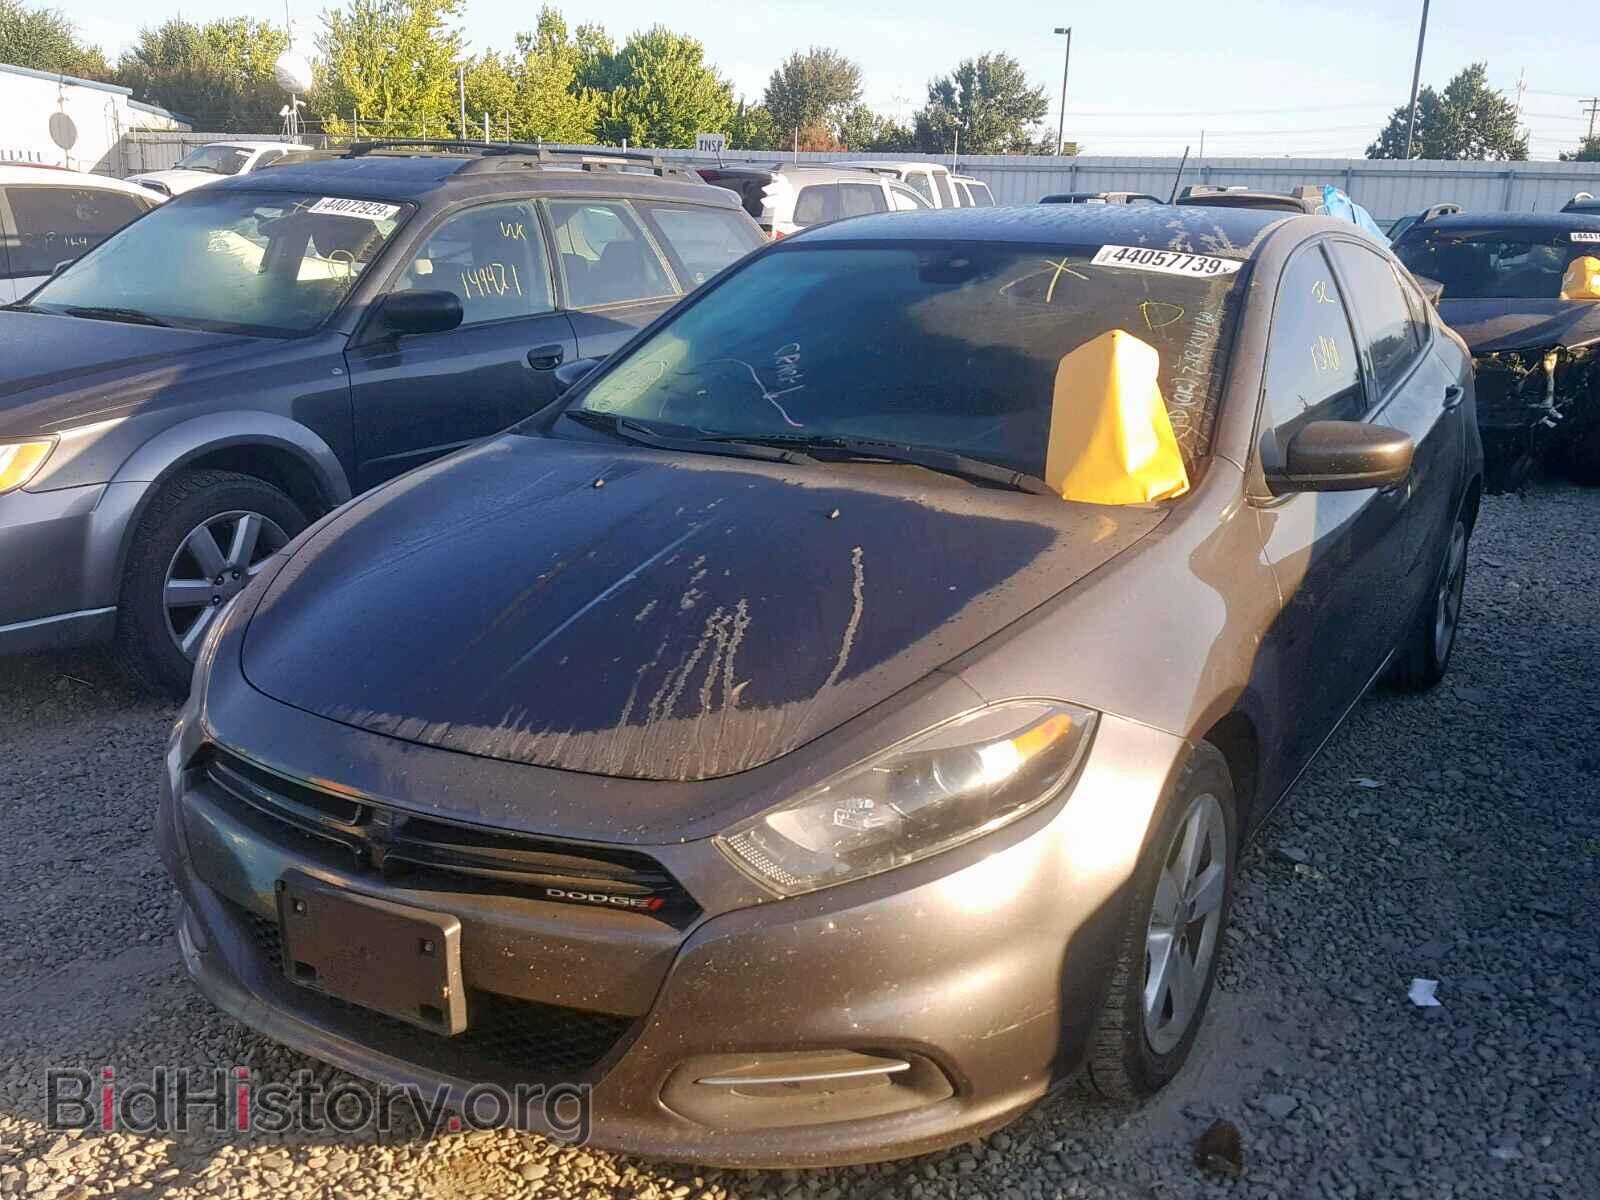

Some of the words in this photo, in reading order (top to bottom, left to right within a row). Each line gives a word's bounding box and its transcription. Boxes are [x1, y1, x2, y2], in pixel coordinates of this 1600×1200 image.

[699, 140, 723, 152] INSP
[1113, 247, 1222, 274] 44057739
[546, 888, 649, 907] DODGE
